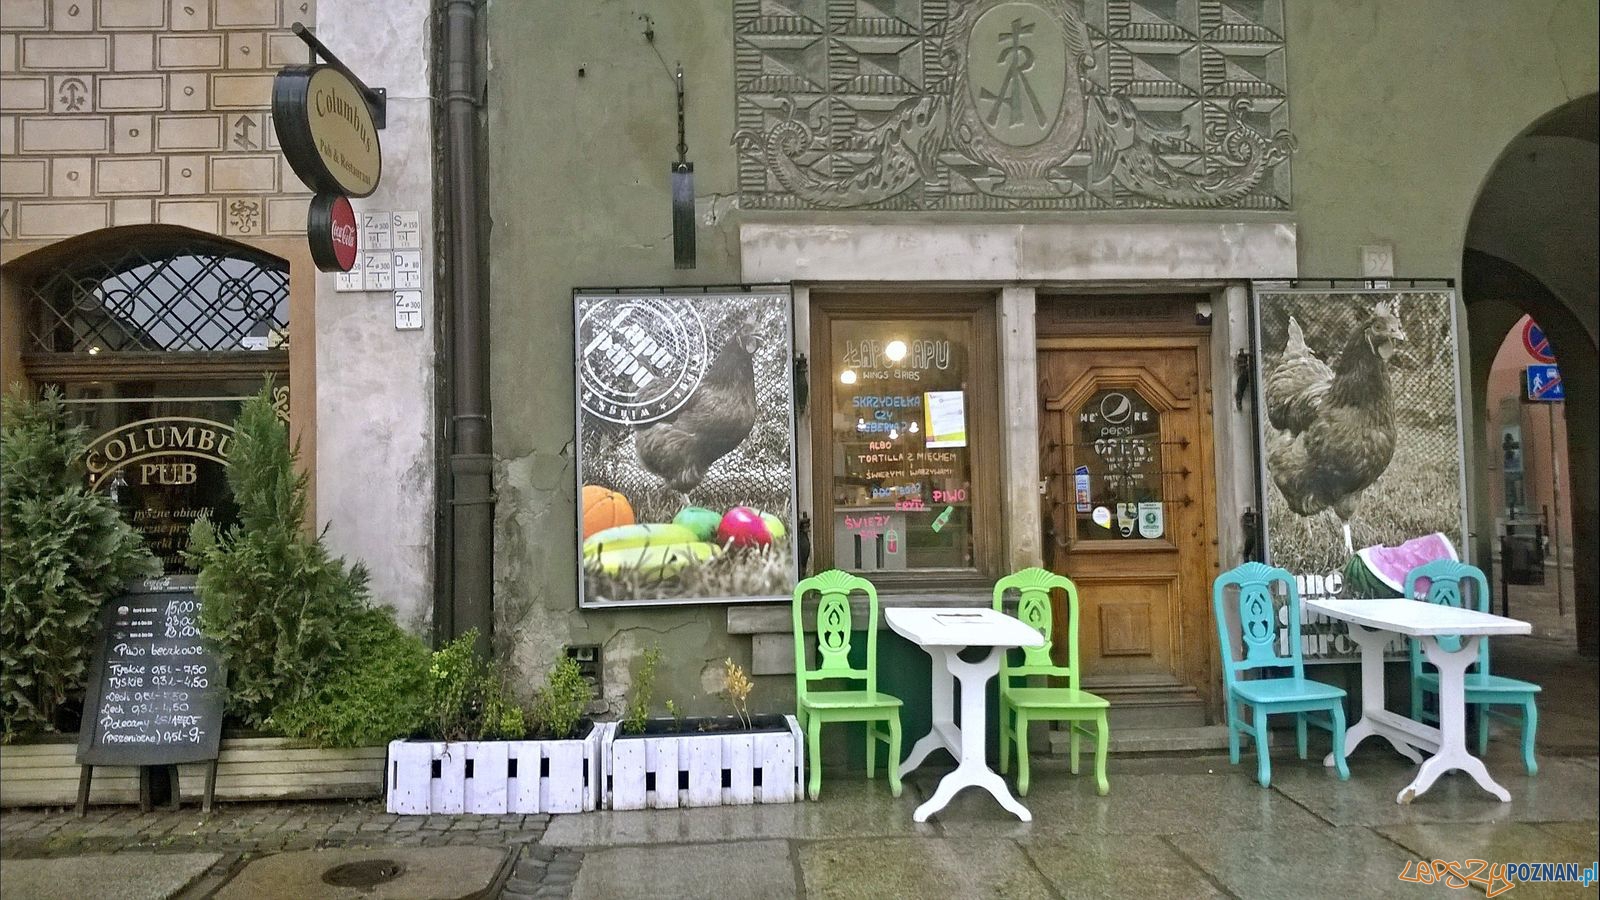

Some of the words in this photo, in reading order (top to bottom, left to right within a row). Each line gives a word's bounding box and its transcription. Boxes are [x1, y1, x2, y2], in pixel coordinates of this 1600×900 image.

[316, 87, 371, 153] Columbus
[340, 155, 371, 186] Restaurant
[365, 216, 373, 228] Z
[394, 215, 402, 227] S
[366, 256, 374, 268] Z
[395, 255, 403, 267] D
[396, 295, 404, 307] Z
[863, 370, 888, 380] WINGS
[901, 371, 920, 381] RIBS
[874, 410, 893, 420] CZY
[1101, 425, 1133, 437] pepsi
[86, 426, 235, 474] COLUMBU
[869, 441, 892, 451] ALBO
[858, 453, 904, 464] TORTILLA
[907, 453, 913, 461] Z
[916, 452, 957, 462] MIĘCHEM
[140, 463, 198, 486] PUB
[909, 469, 953, 477] WARZYWAMI
[932, 488, 966, 502] PIWO
[173, 506, 215, 520] obiadki
[844, 513, 891, 530] ŚWIEŻY
[114, 643, 146, 657] Piwo
[151, 643, 203, 656] beczkowe
[109, 664, 146, 677] Tyskie
[109, 676, 144, 689] Tyskie
[184, 676, 208, 689] 4,50
[101, 703, 125, 715] Lech
